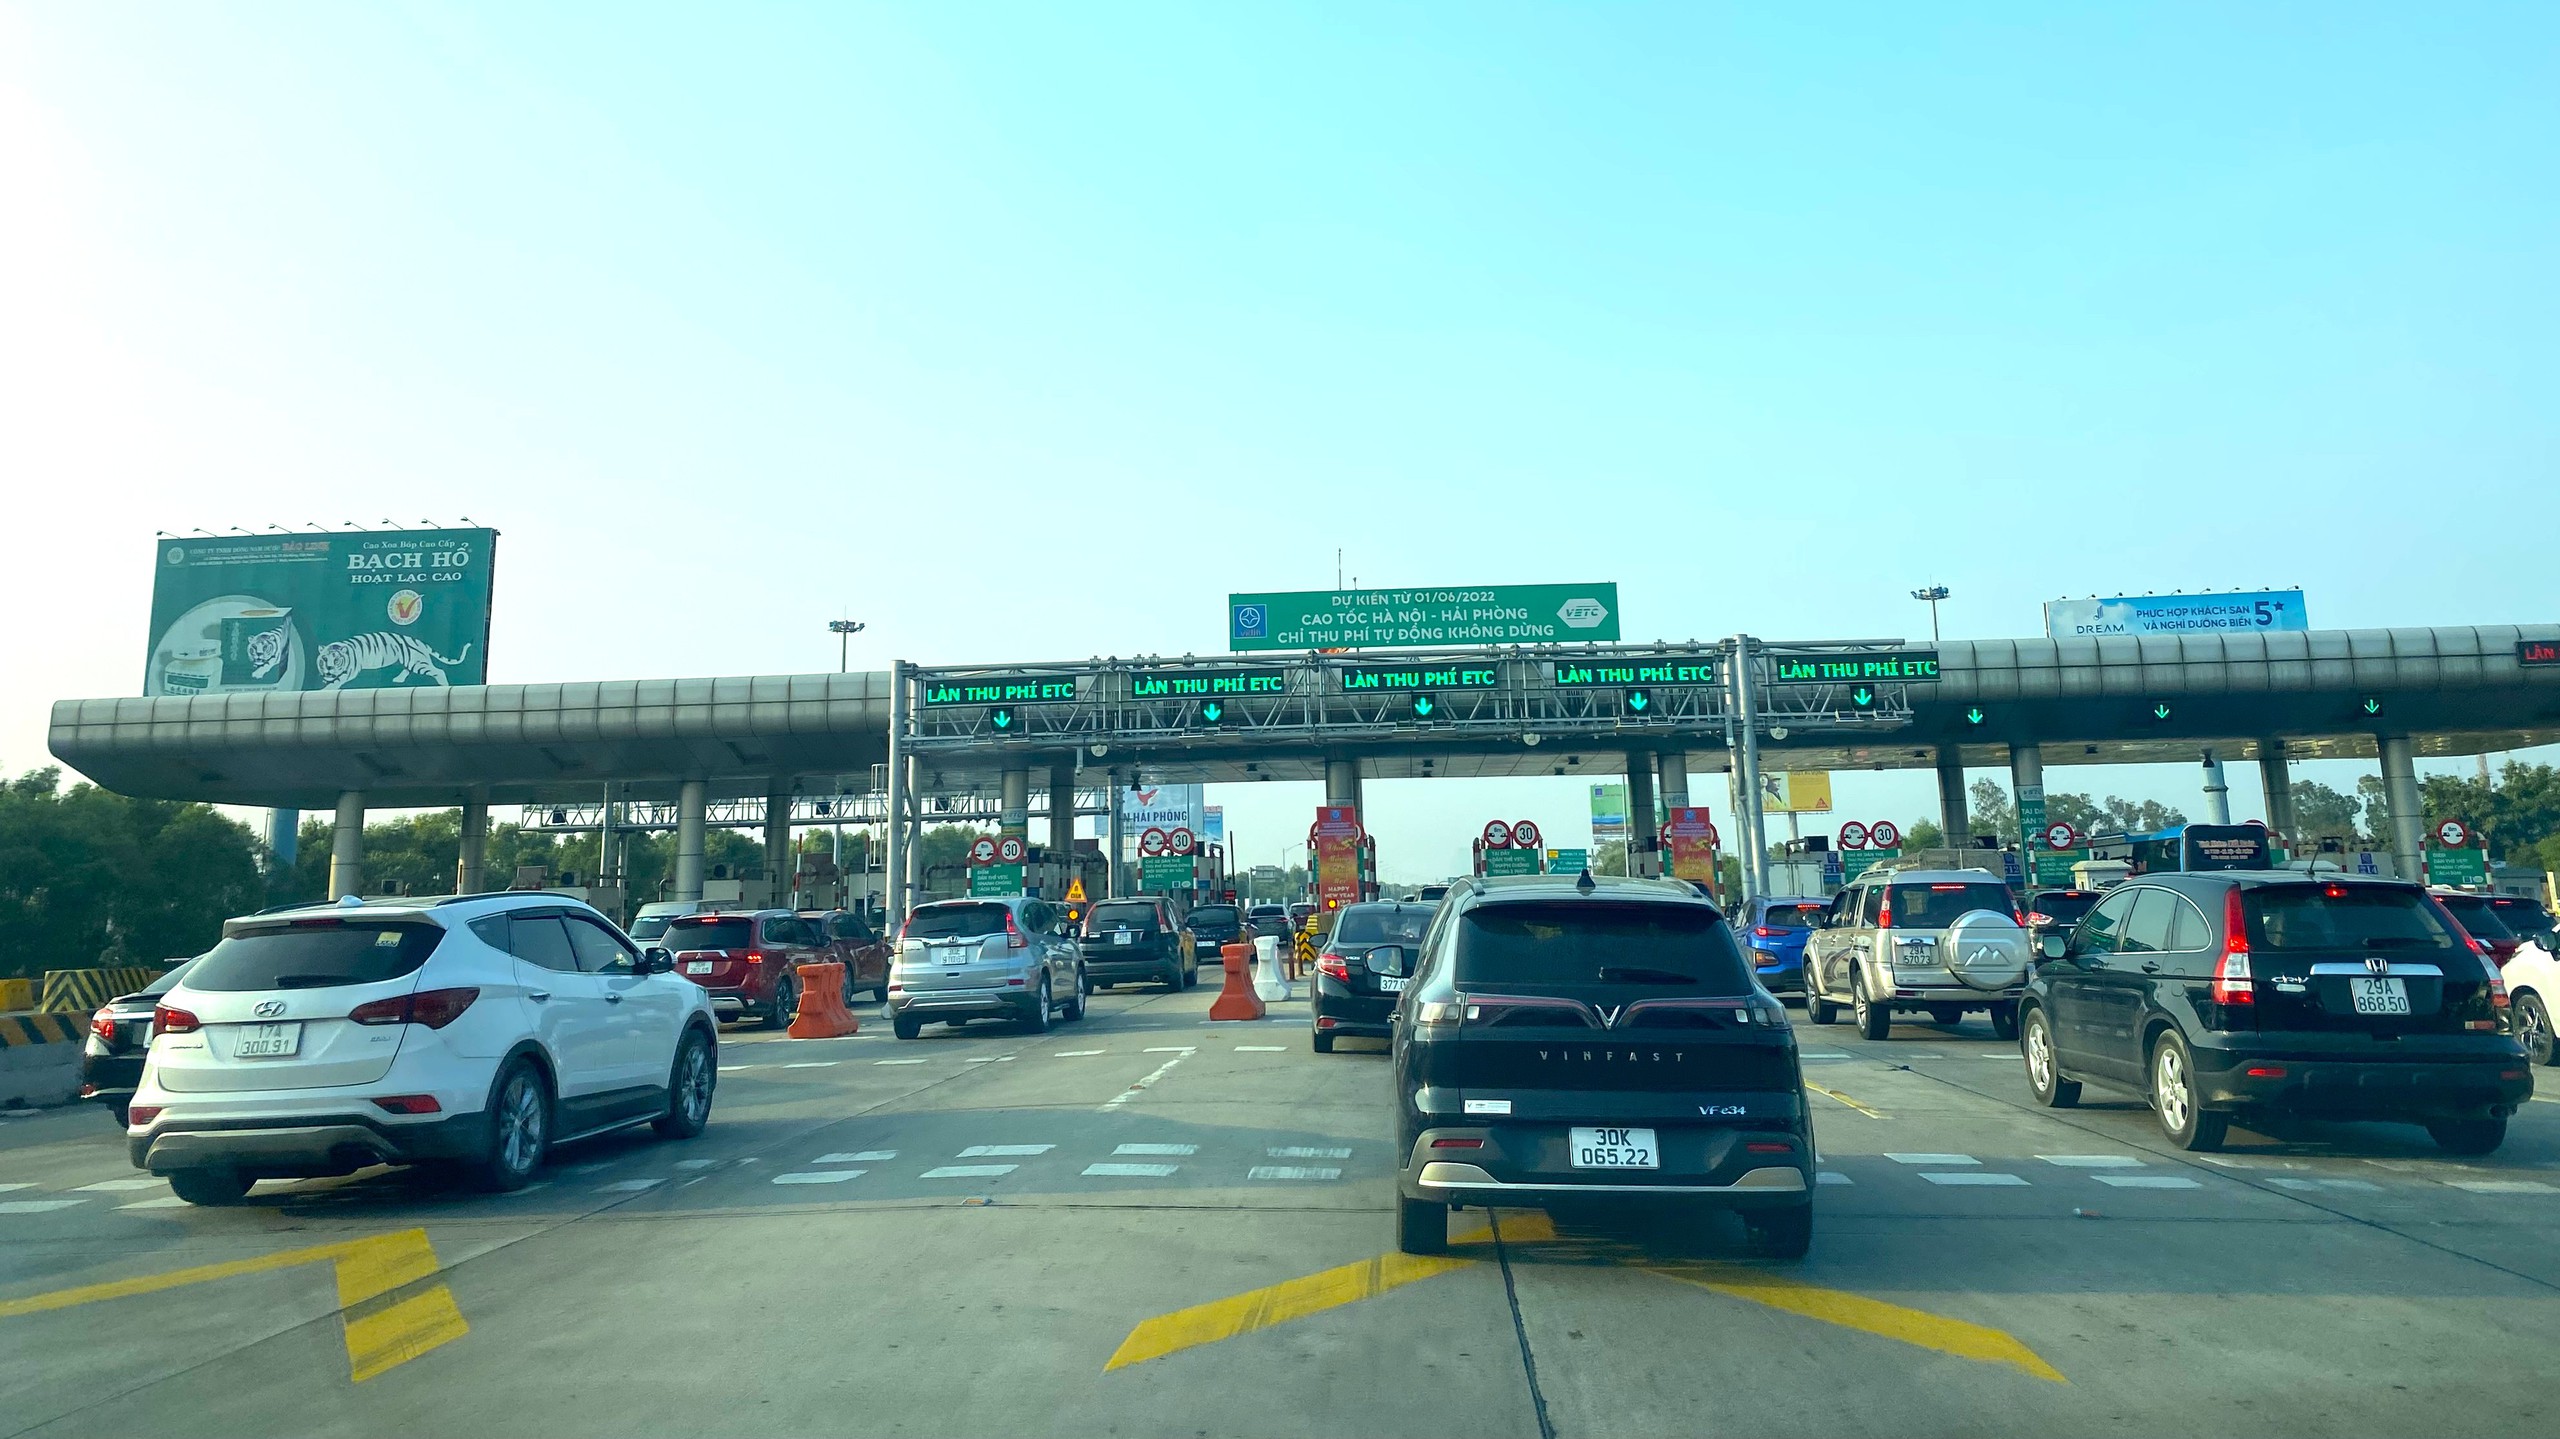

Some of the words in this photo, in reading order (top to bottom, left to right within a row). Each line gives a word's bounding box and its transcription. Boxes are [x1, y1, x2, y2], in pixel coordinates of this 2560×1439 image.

[381, 541, 397, 549] Xoa
[400, 541, 417, 549] Bóp
[419, 540, 436, 548] Cao
[438, 539, 455, 547] Cấp
[347, 553, 422, 572] BẠCH
[431, 542, 469, 567] HỔ
[351, 574, 393, 585] HOẠT
[397, 574, 427, 583] LẠC
[432, 572, 462, 581] CAO
[1332, 595, 1352, 609] DỰ
[1356, 593, 1389, 606] KIẾN
[1393, 592, 1411, 604] TỪ
[1414, 591, 1495, 603] 01/06/2022
[1301, 614, 1333, 626] CAO
[1337, 610, 1367, 624] TỐC
[1372, 610, 1394, 623] HÀ
[1398, 608, 1426, 625] NỘI
[1441, 606, 1468, 621] HẢI
[1473, 605, 1528, 620] PHÒNG
[1565, 608, 1599, 617] VETC
[2254, 601, 2273, 625] 5
[1277, 628, 1304, 643] CHỈ
[1308, 630, 1339, 642] THU
[1344, 627, 1370, 641] PHÍ
[1374, 628, 1395, 643] TỰ
[1398, 624, 1443, 642] ĐỘNG
[1449, 624, 1504, 638] KHÔNG
[1509, 622, 1554, 637] DỪNG
[2076, 624, 2125, 633] DREAM
[1557, 664, 1592, 683] LÀN
[1597, 667, 1634, 682] THU
[1640, 662, 1673, 681] PHÍ
[1678, 665, 1712, 681] ETC
[1779, 659, 1816, 678] LÀN
[1820, 661, 1858, 677] THU
[1864, 656, 1899, 676] PHÍ
[1903, 660, 1937, 675] ETC
[1135, 675, 1167, 695] LÀN
[1172, 678, 1208, 693] THU
[1213, 672, 1245, 692] PHÍ
[1250, 676, 1282, 691] ETC
[1344, 669, 1378, 688] LÀN
[1383, 672, 1419, 687] THU
[1425, 666, 1457, 685] PHÍ
[1462, 670, 1495, 685] ETC
[927, 683, 960, 703] LÀN
[964, 686, 1000, 700] THU
[1005, 680, 1037, 699] PHÍ
[1042, 683, 1074, 698] ETC
[1133, 809, 1150, 823] HẢI
[1153, 808, 1187, 822] PHÒNG
[1175, 834, 1188, 848] 30
[1520, 827, 1533, 841] 30
[1877, 828, 1892, 841] 30
[1004, 844, 1018, 857] 30
[1909, 946, 1925, 955] 29A
[2365, 980, 2393, 995] 29A
[2358, 996, 2407, 1012] 868.50
[257, 1024, 282, 1038] 17A
[241, 1039, 290, 1055] 300.91
[1540, 1051, 1683, 1062] VINFAST
[1699, 1106, 1719, 1115] VF
[1720, 1106, 1747, 1115] e34
[1595, 1129, 1632, 1146] 30K
[1582, 1148, 1649, 1166] 065.22
